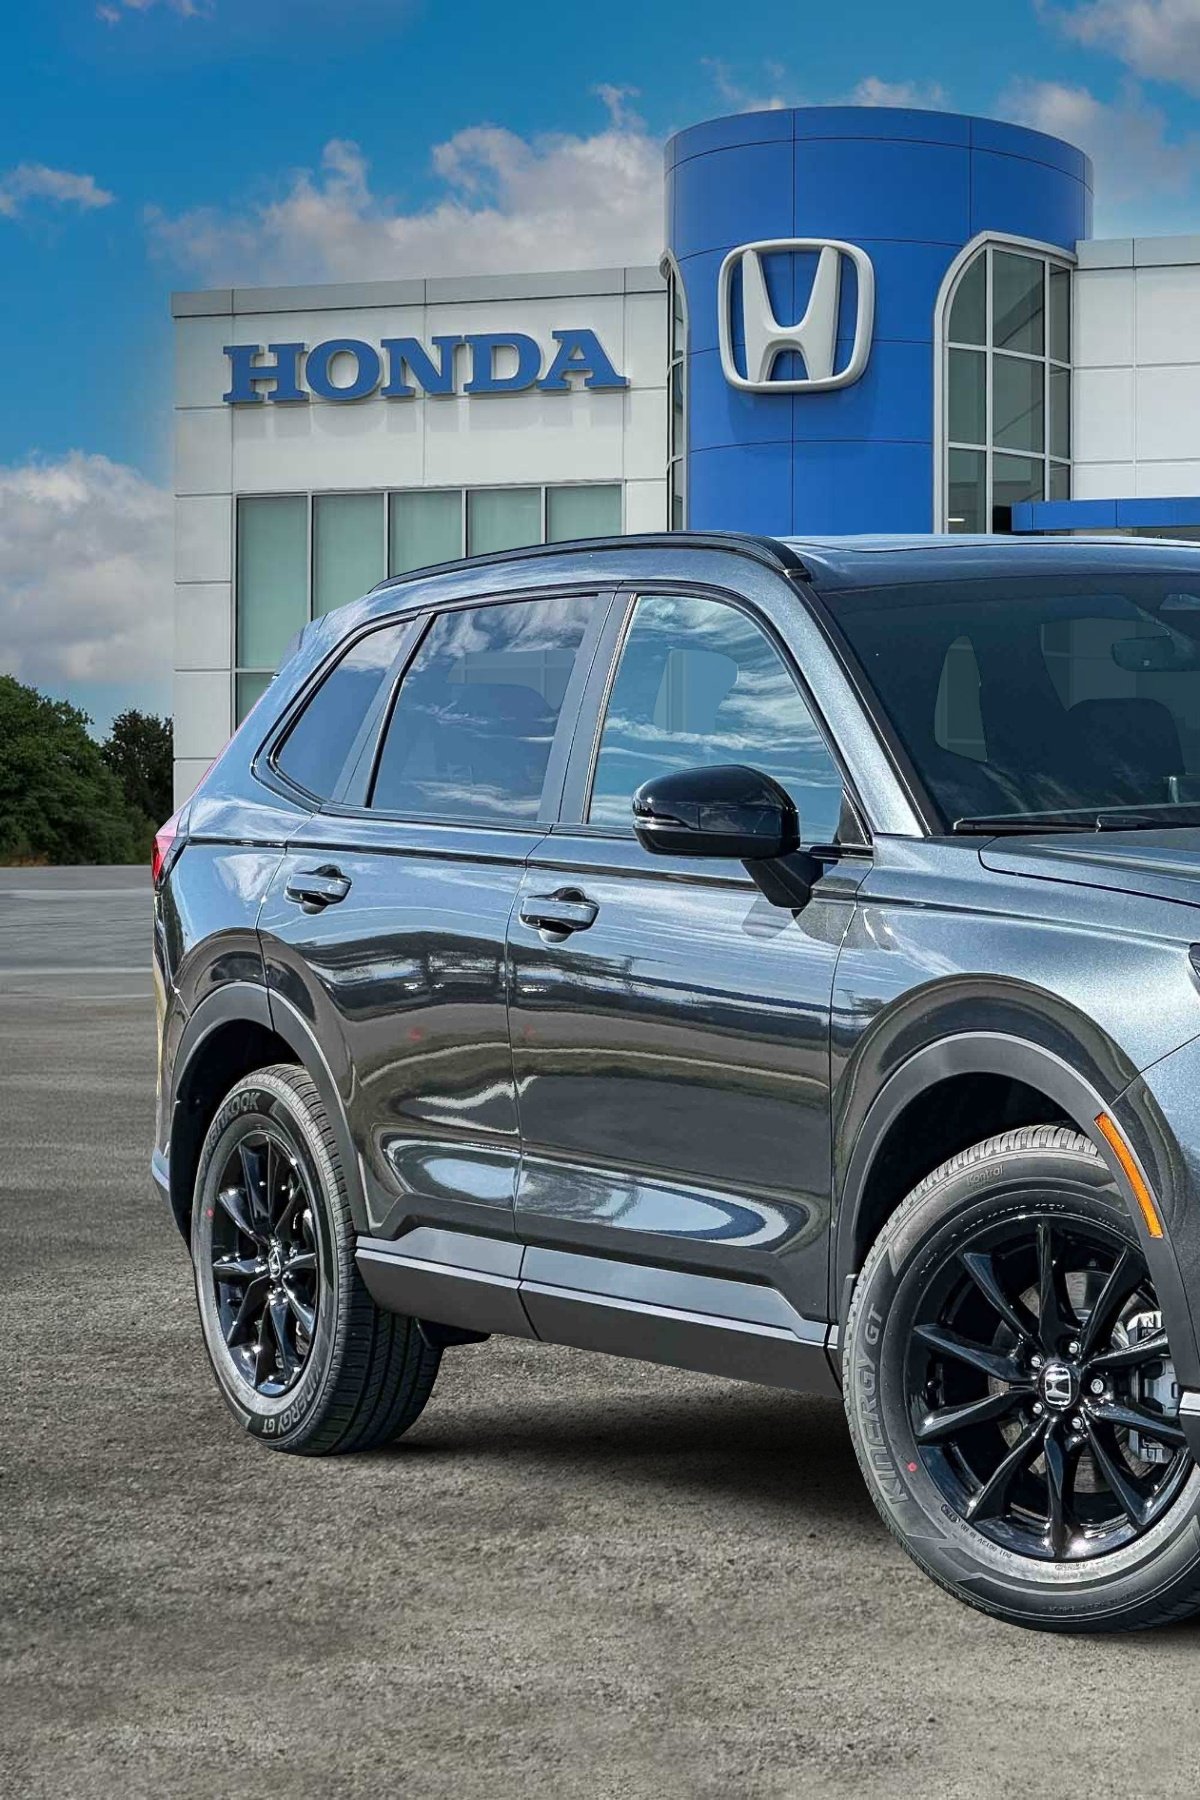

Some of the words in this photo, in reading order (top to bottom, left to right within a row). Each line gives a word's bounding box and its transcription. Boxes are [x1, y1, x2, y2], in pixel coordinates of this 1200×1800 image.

[222, 328, 630, 405] HONDA
[864, 1303, 883, 1346] GT
[261, 1417, 276, 1434] GT
[856, 1349, 910, 1505] KINERGY
